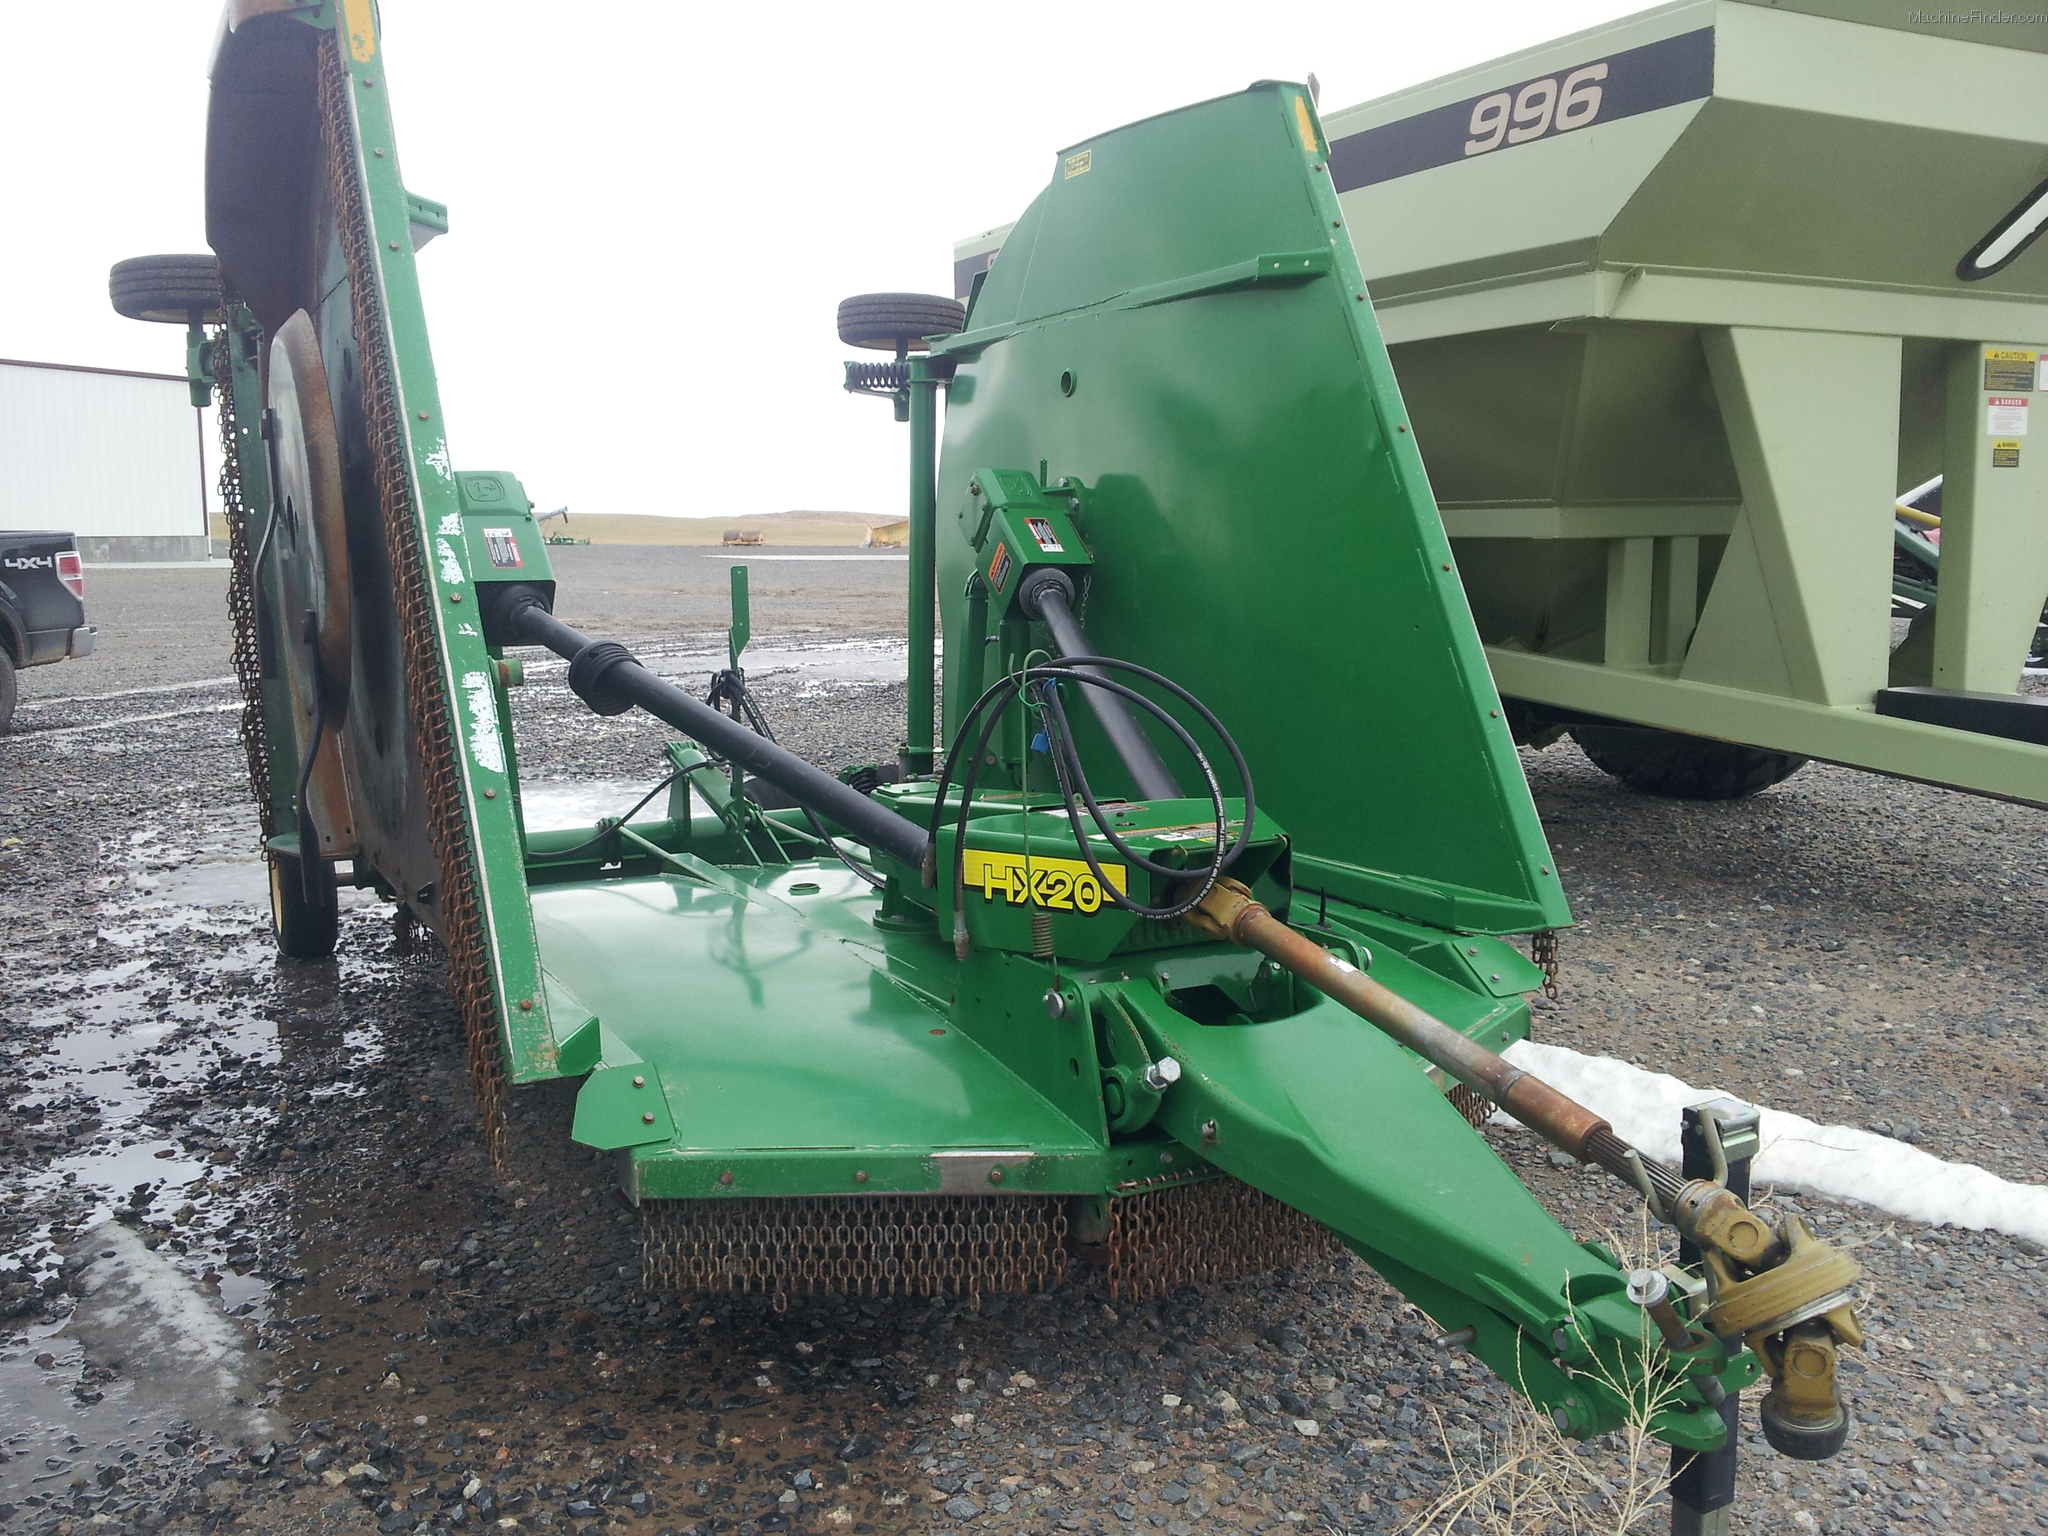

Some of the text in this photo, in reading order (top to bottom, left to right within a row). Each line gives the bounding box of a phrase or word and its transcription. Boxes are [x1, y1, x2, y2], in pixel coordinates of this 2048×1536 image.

[1465, 63, 1608, 155] 996
[2000, 351, 2028, 360] CAUTION
[984, 863, 1102, 914] HX20
[1205, 877, 1215, 890] MAX
